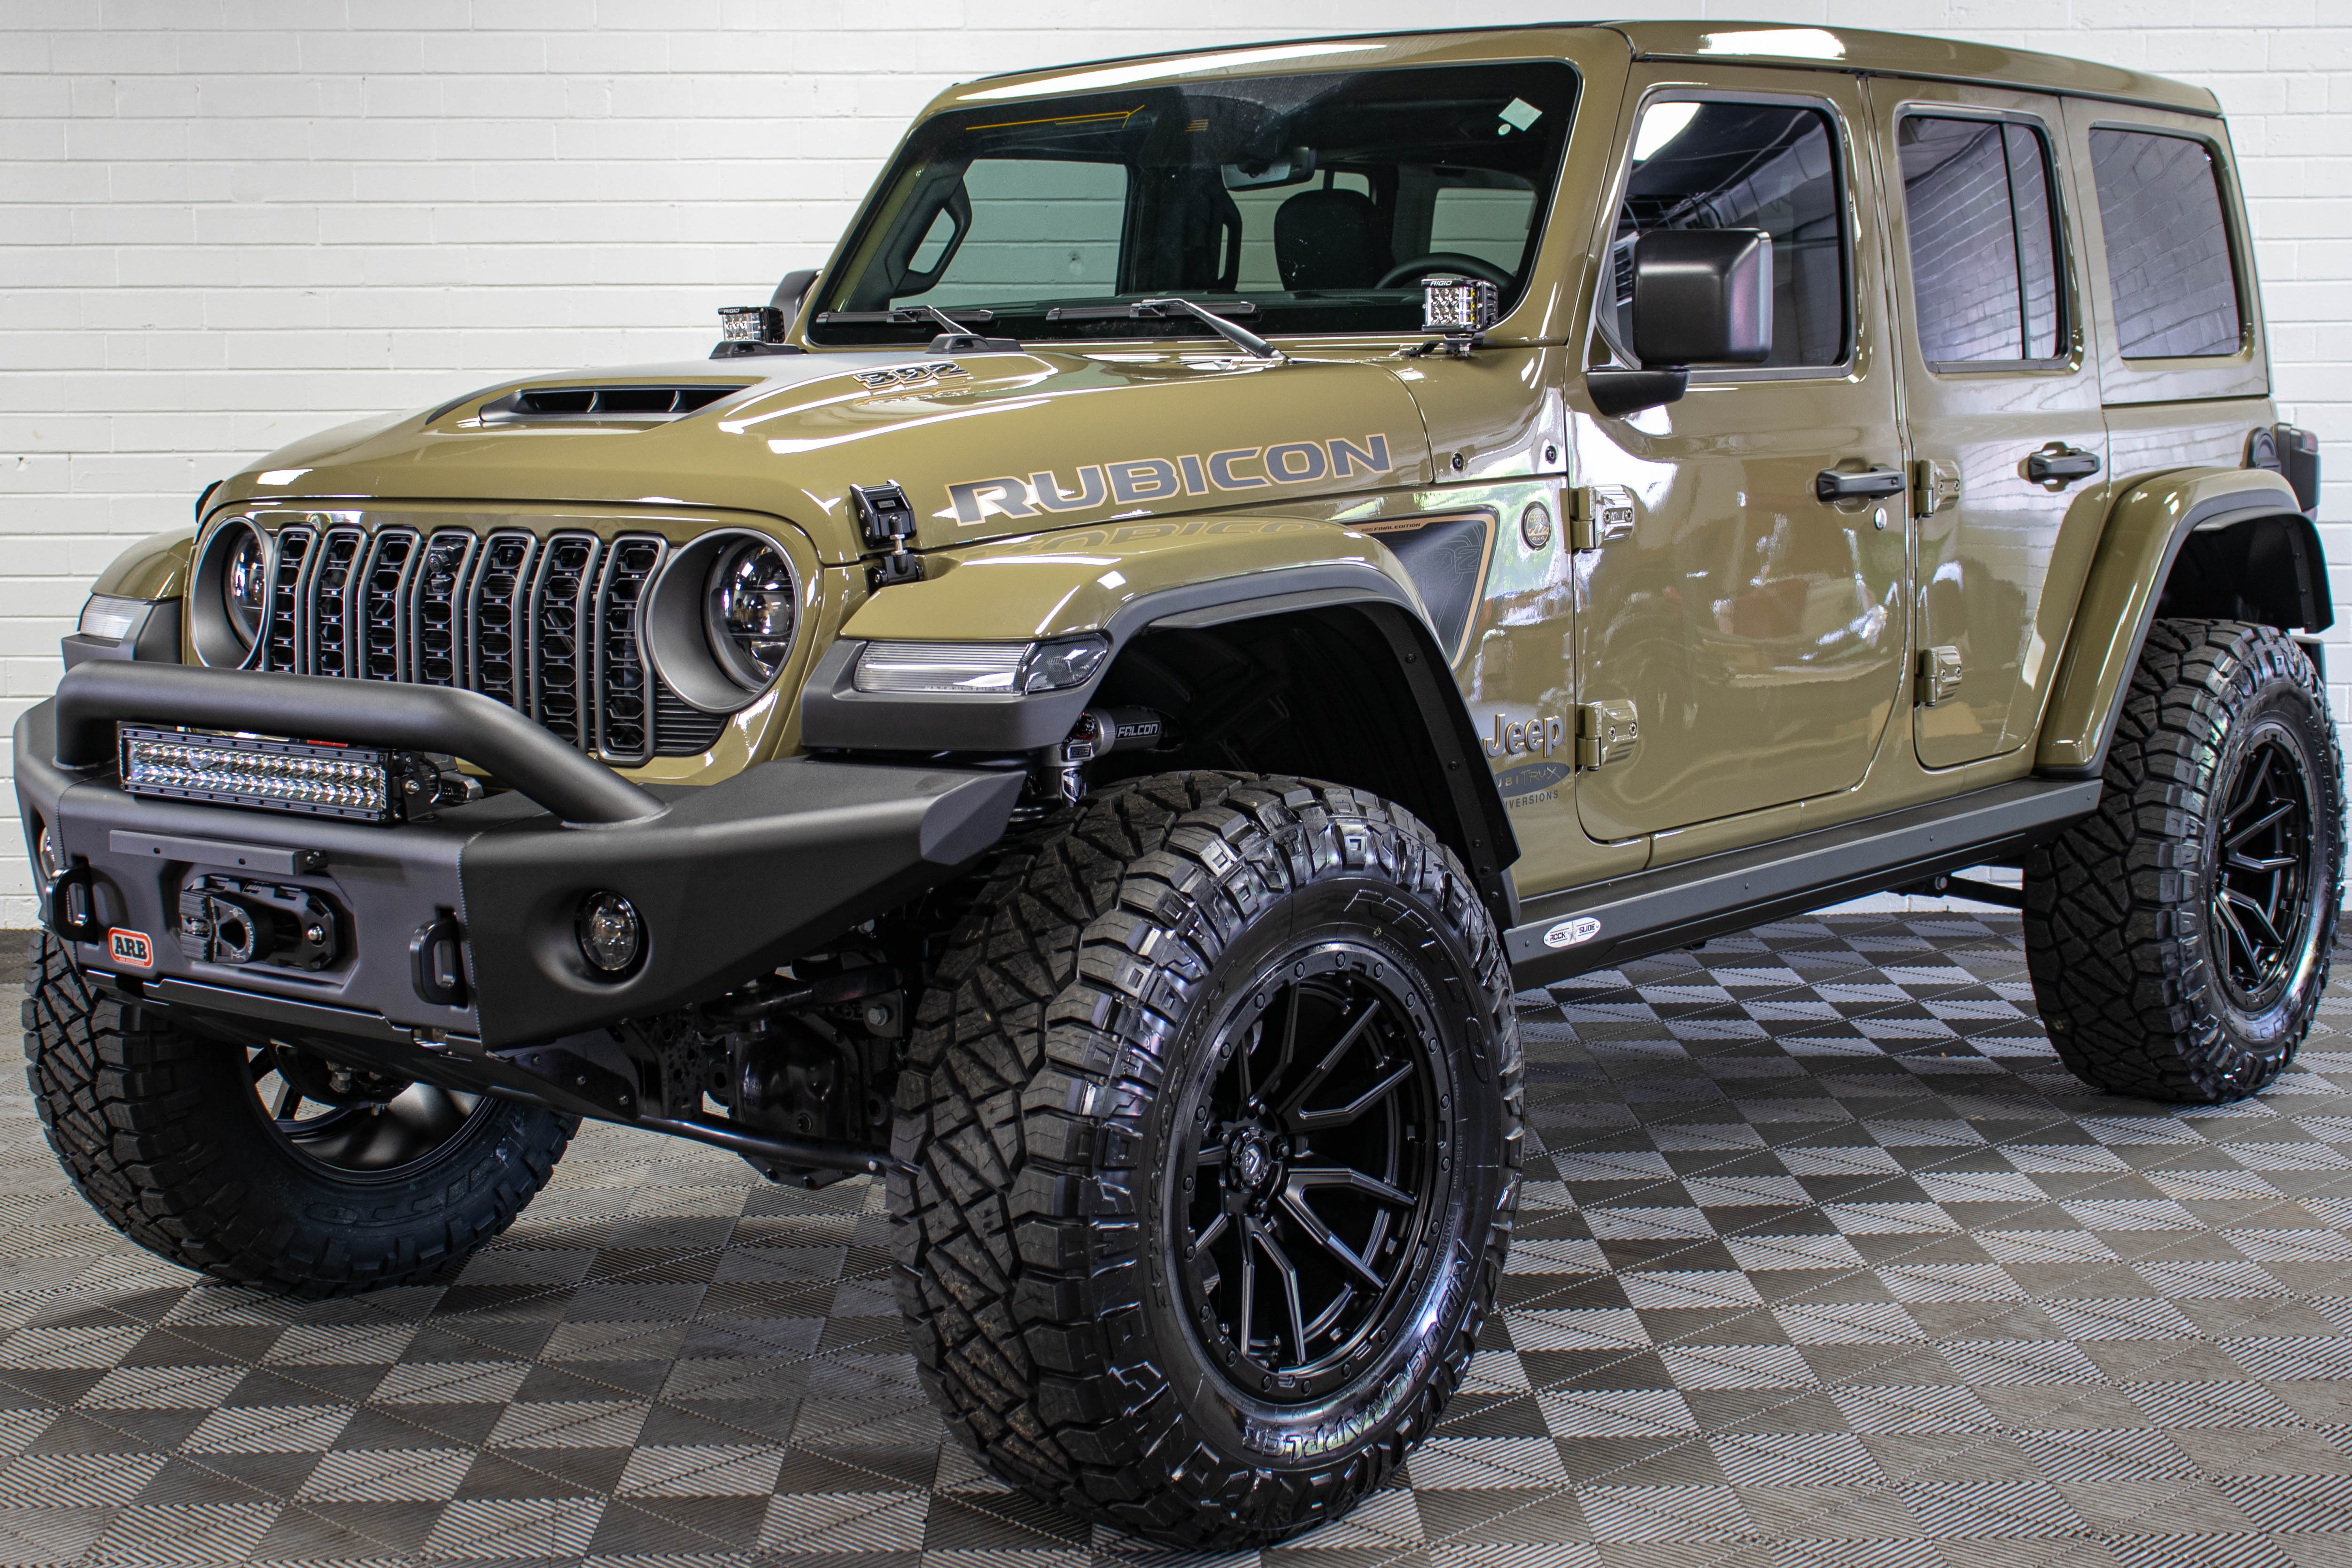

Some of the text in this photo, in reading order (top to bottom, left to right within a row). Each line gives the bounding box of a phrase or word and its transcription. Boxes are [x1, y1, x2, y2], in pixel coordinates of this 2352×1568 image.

[853, 362, 971, 390] 392
[944, 433, 1393, 527] RUBICON
[1117, 723, 1158, 738] FALCON
[1482, 713, 1564, 758] Jeep
[379, 766, 387, 809] RIGID
[114, 936, 147, 960] ARB
[1550, 923, 1596, 942] ROCK SLIDE
[1242, 1238, 1474, 1464] RIDGE GRAPPLER
